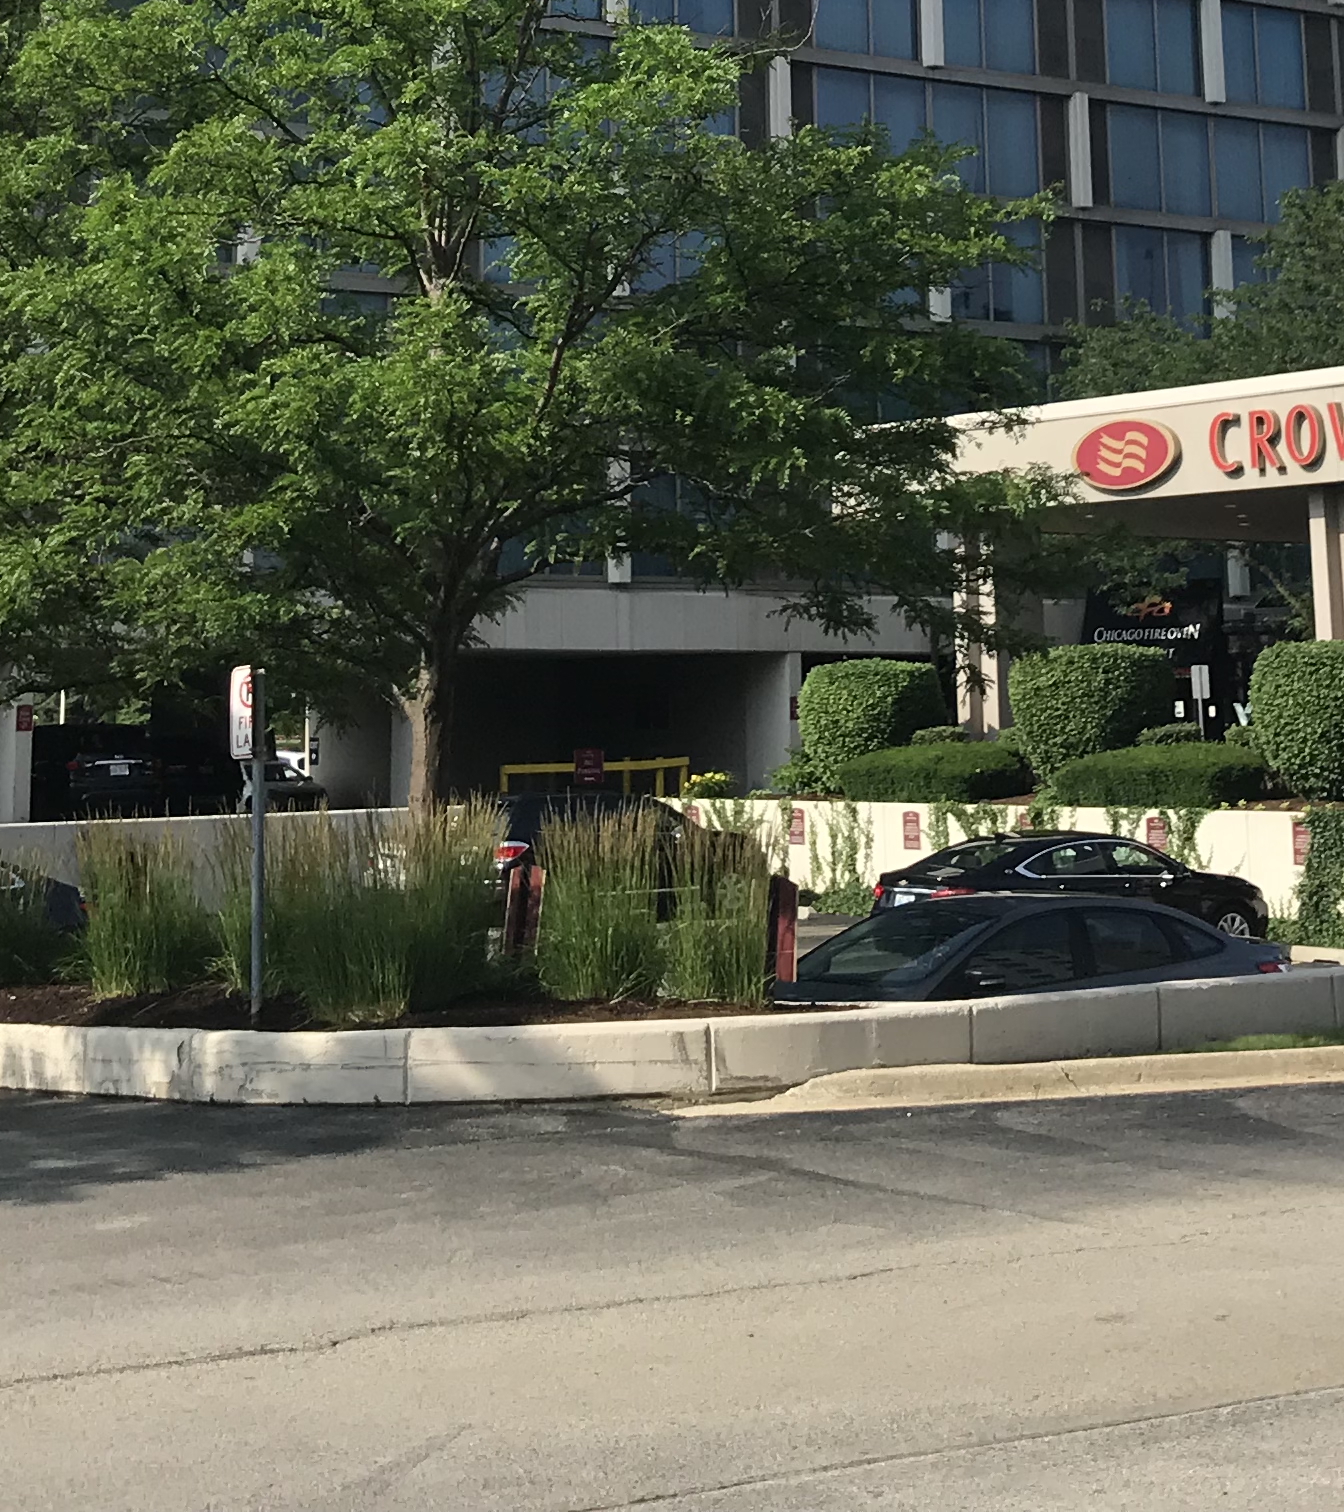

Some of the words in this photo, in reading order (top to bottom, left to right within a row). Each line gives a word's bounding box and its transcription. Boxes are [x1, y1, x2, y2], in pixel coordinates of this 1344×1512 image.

[1094, 627, 1143, 642] CHICAGO
[1144, 628, 1166, 640] FIRE
[236, 734, 251, 748] LA
